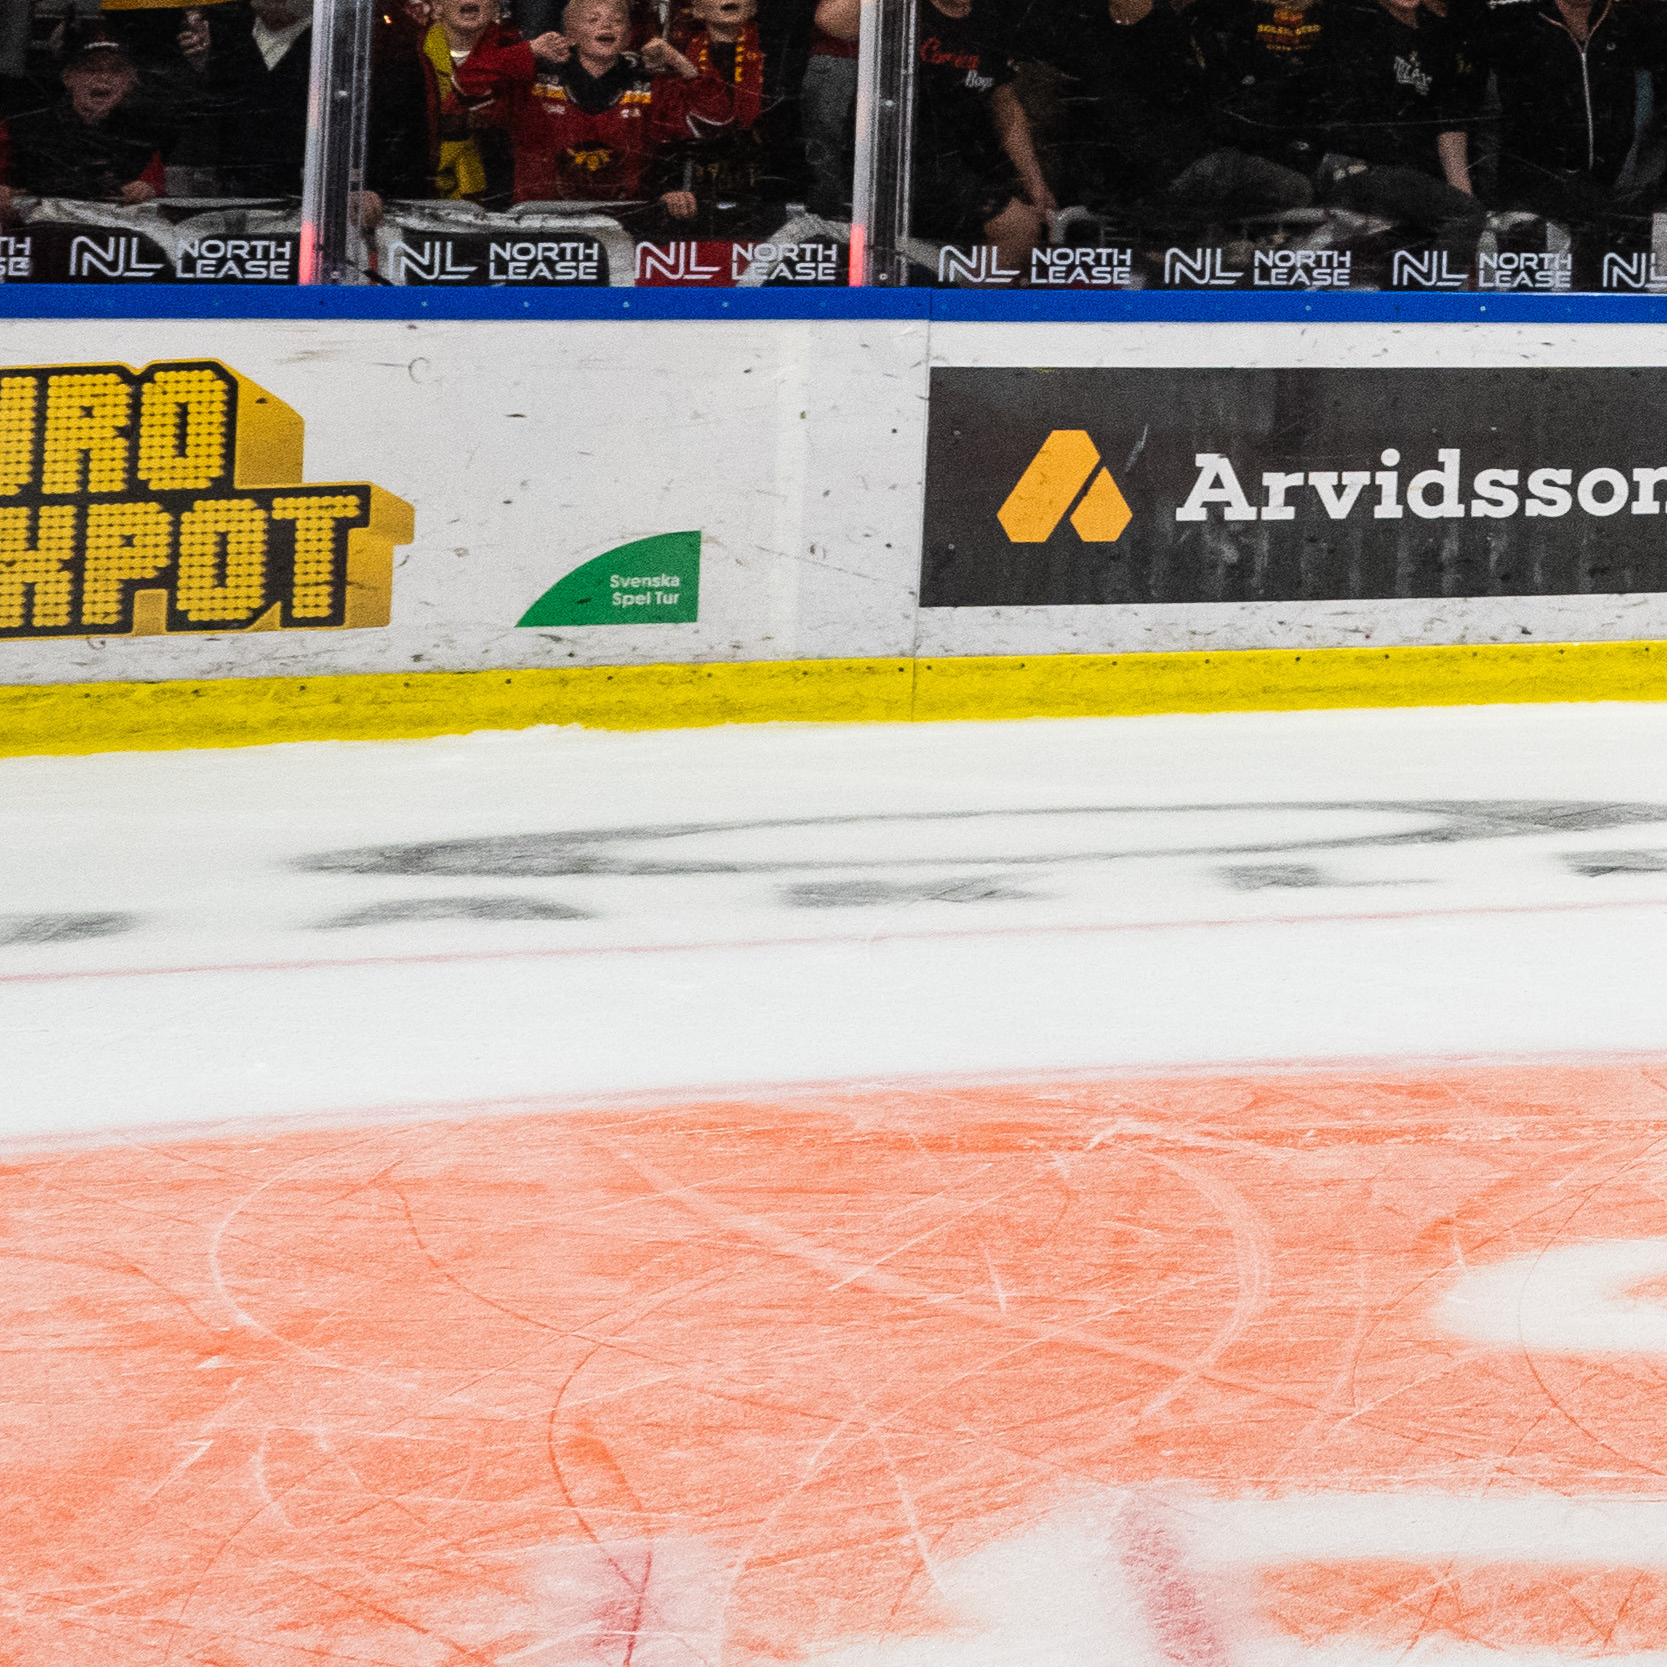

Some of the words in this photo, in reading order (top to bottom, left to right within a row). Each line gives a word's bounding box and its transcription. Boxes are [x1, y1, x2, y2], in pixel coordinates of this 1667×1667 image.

[182, 239, 292, 259] NORTH
[489, 241, 598, 261] NORTH
[732, 243, 837, 261] NORTH
[1032, 248, 1131, 265] NORTH
[1254, 250, 1351, 267] NORTH
[1479, 253, 1572, 269] NORTH
[176, 260, 292, 279] LEASE
[488, 262, 598, 280] LEASE
[732, 262, 837, 280] LEASE
[1032, 266, 1131, 284] LEASE
[1254, 268, 1350, 285] LEASE
[1479, 270, 1572, 287] LEASE
[610, 573, 681, 590] Svenska
[612, 591, 651, 608] Spel
[655, 591, 680, 607] Tur
